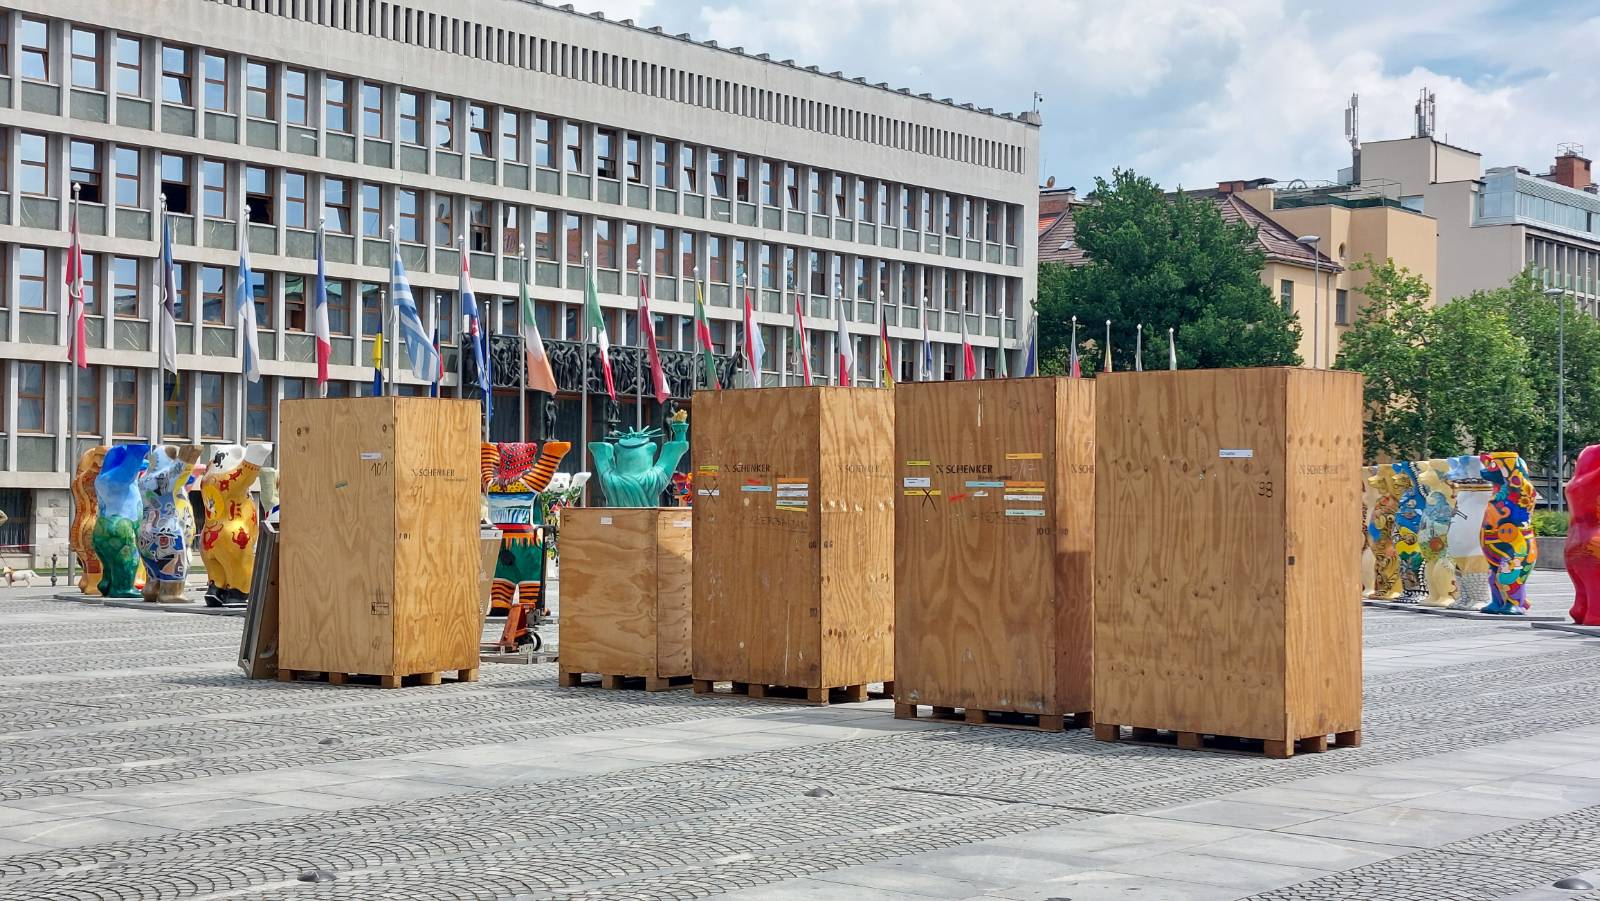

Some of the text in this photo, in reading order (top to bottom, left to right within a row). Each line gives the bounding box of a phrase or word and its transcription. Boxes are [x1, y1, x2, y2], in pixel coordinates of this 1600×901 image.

[370, 462, 388, 477] 101
[418, 469, 455, 477] SCHENKER
[732, 464, 771, 473] SCHENKER
[945, 464, 993, 474] SCHENKER
